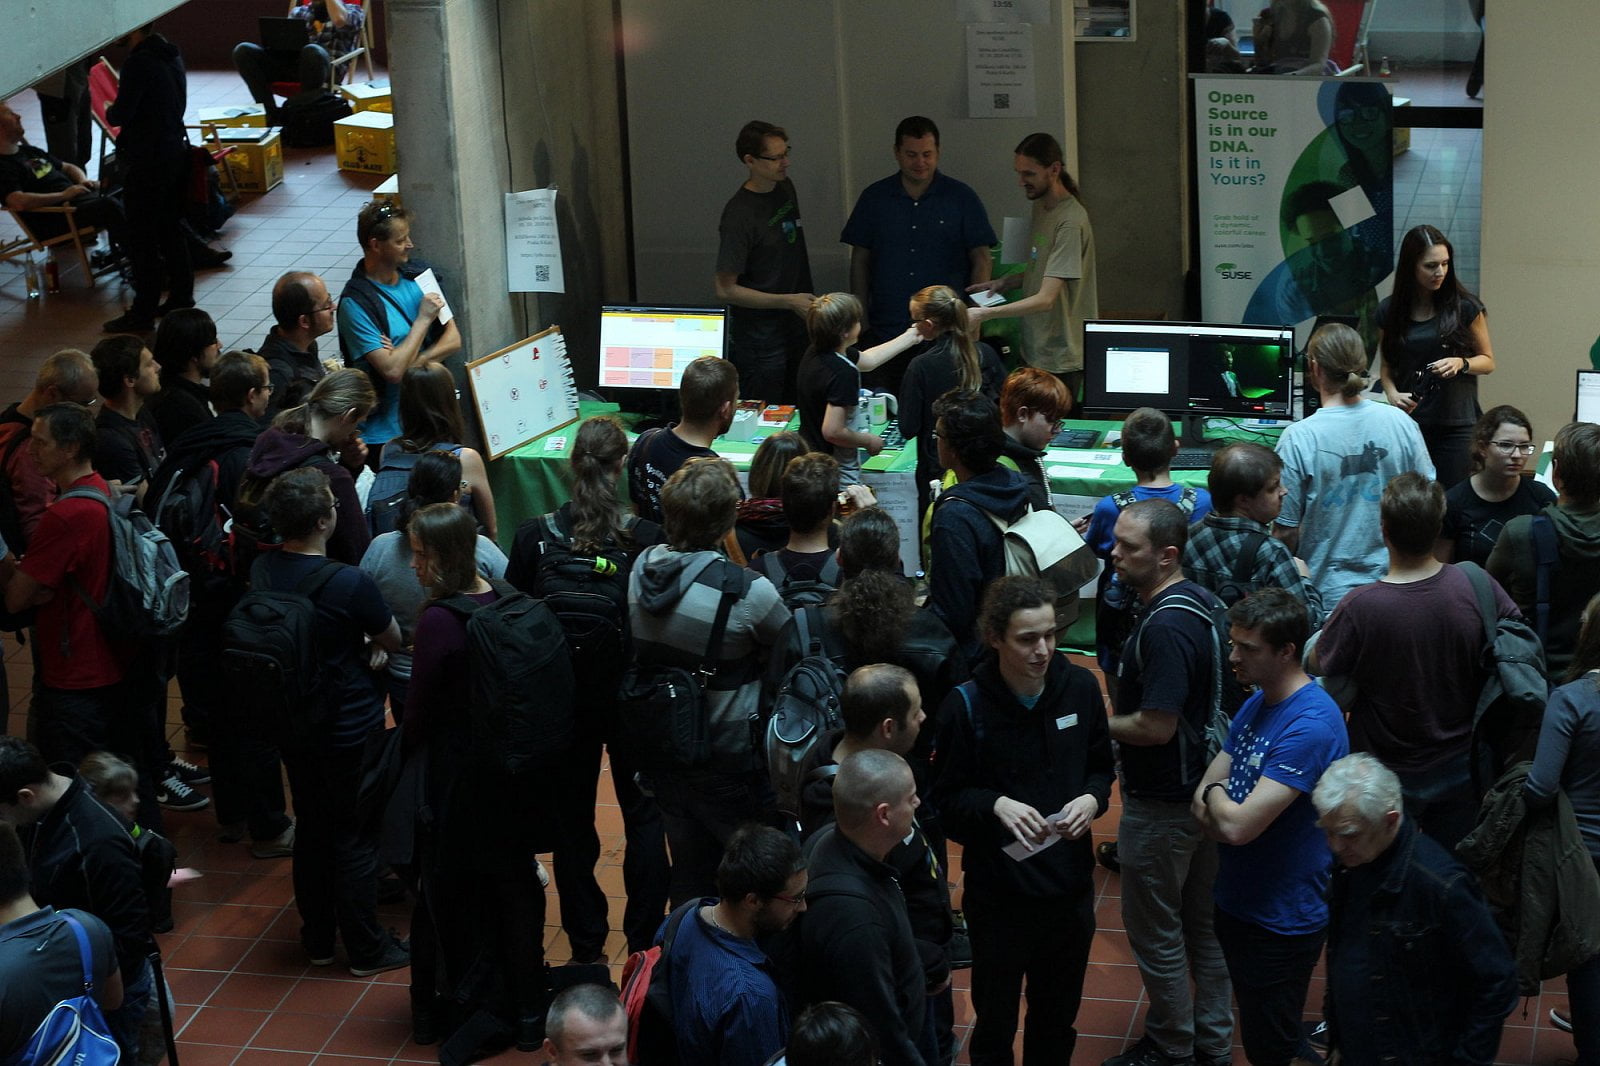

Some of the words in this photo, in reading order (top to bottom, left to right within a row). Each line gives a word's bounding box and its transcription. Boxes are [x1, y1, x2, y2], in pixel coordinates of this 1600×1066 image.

[1208, 91, 1255, 106] Open
[1208, 107, 1268, 120] Source
[1209, 123, 1222, 136] is
[1227, 124, 1243, 136] in
[1248, 126, 1277, 137] our
[1209, 140, 1254, 153] DNA.
[1210, 156, 1223, 169] Is
[1229, 156, 1240, 169] it
[1246, 156, 1261, 169] in
[1210, 173, 1266, 186] Yours?
[1221, 271, 1253, 279] SUSE
